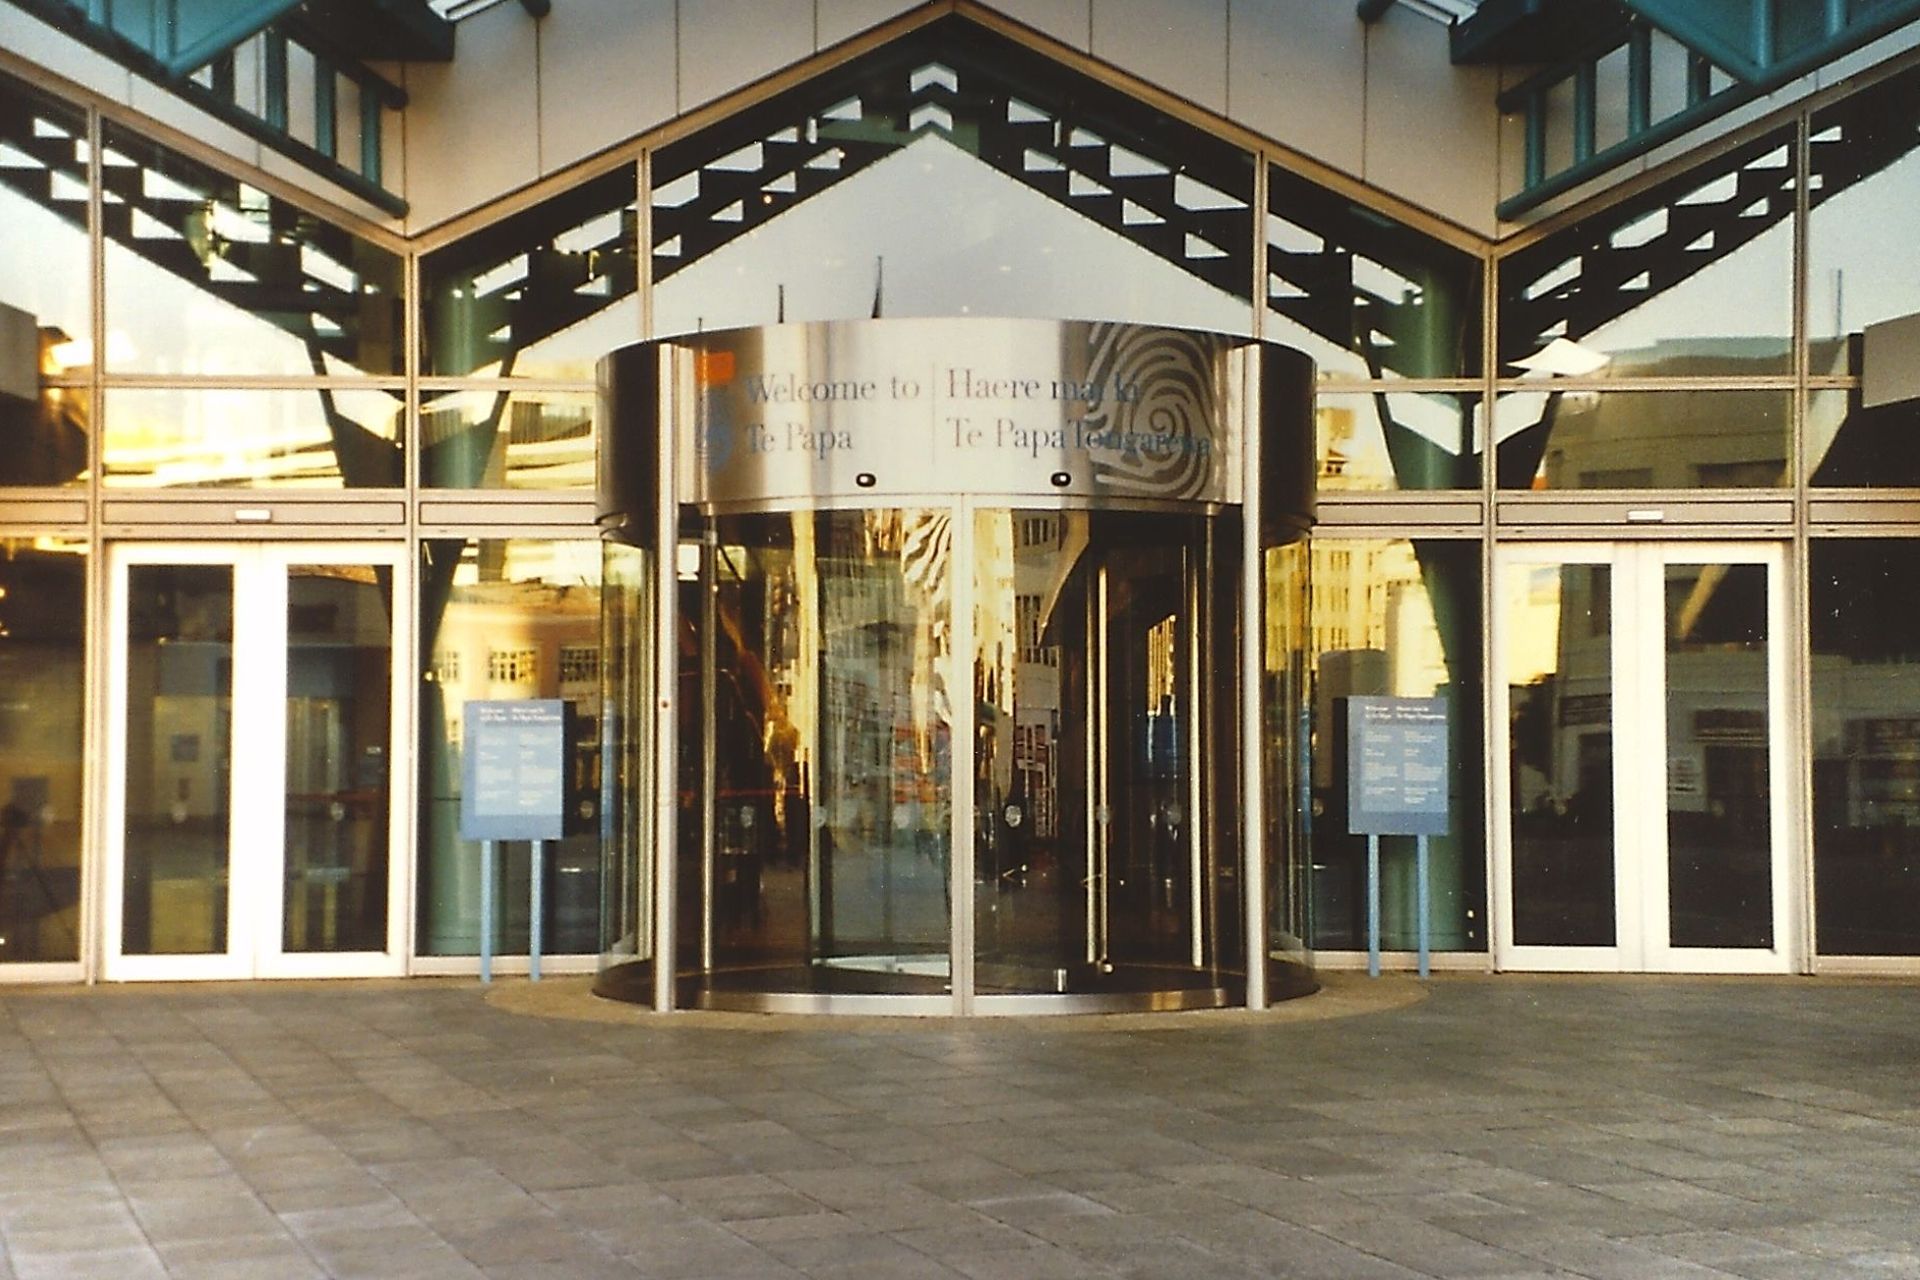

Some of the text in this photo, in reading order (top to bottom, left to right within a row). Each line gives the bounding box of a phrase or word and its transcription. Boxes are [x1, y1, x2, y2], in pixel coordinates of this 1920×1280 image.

[749, 373, 920, 403] Welcome to
[949, 368, 1040, 400] Haere
[747, 422, 852, 459] Te Papa
[946, 416, 1210, 458] Te Papa Tongarea
